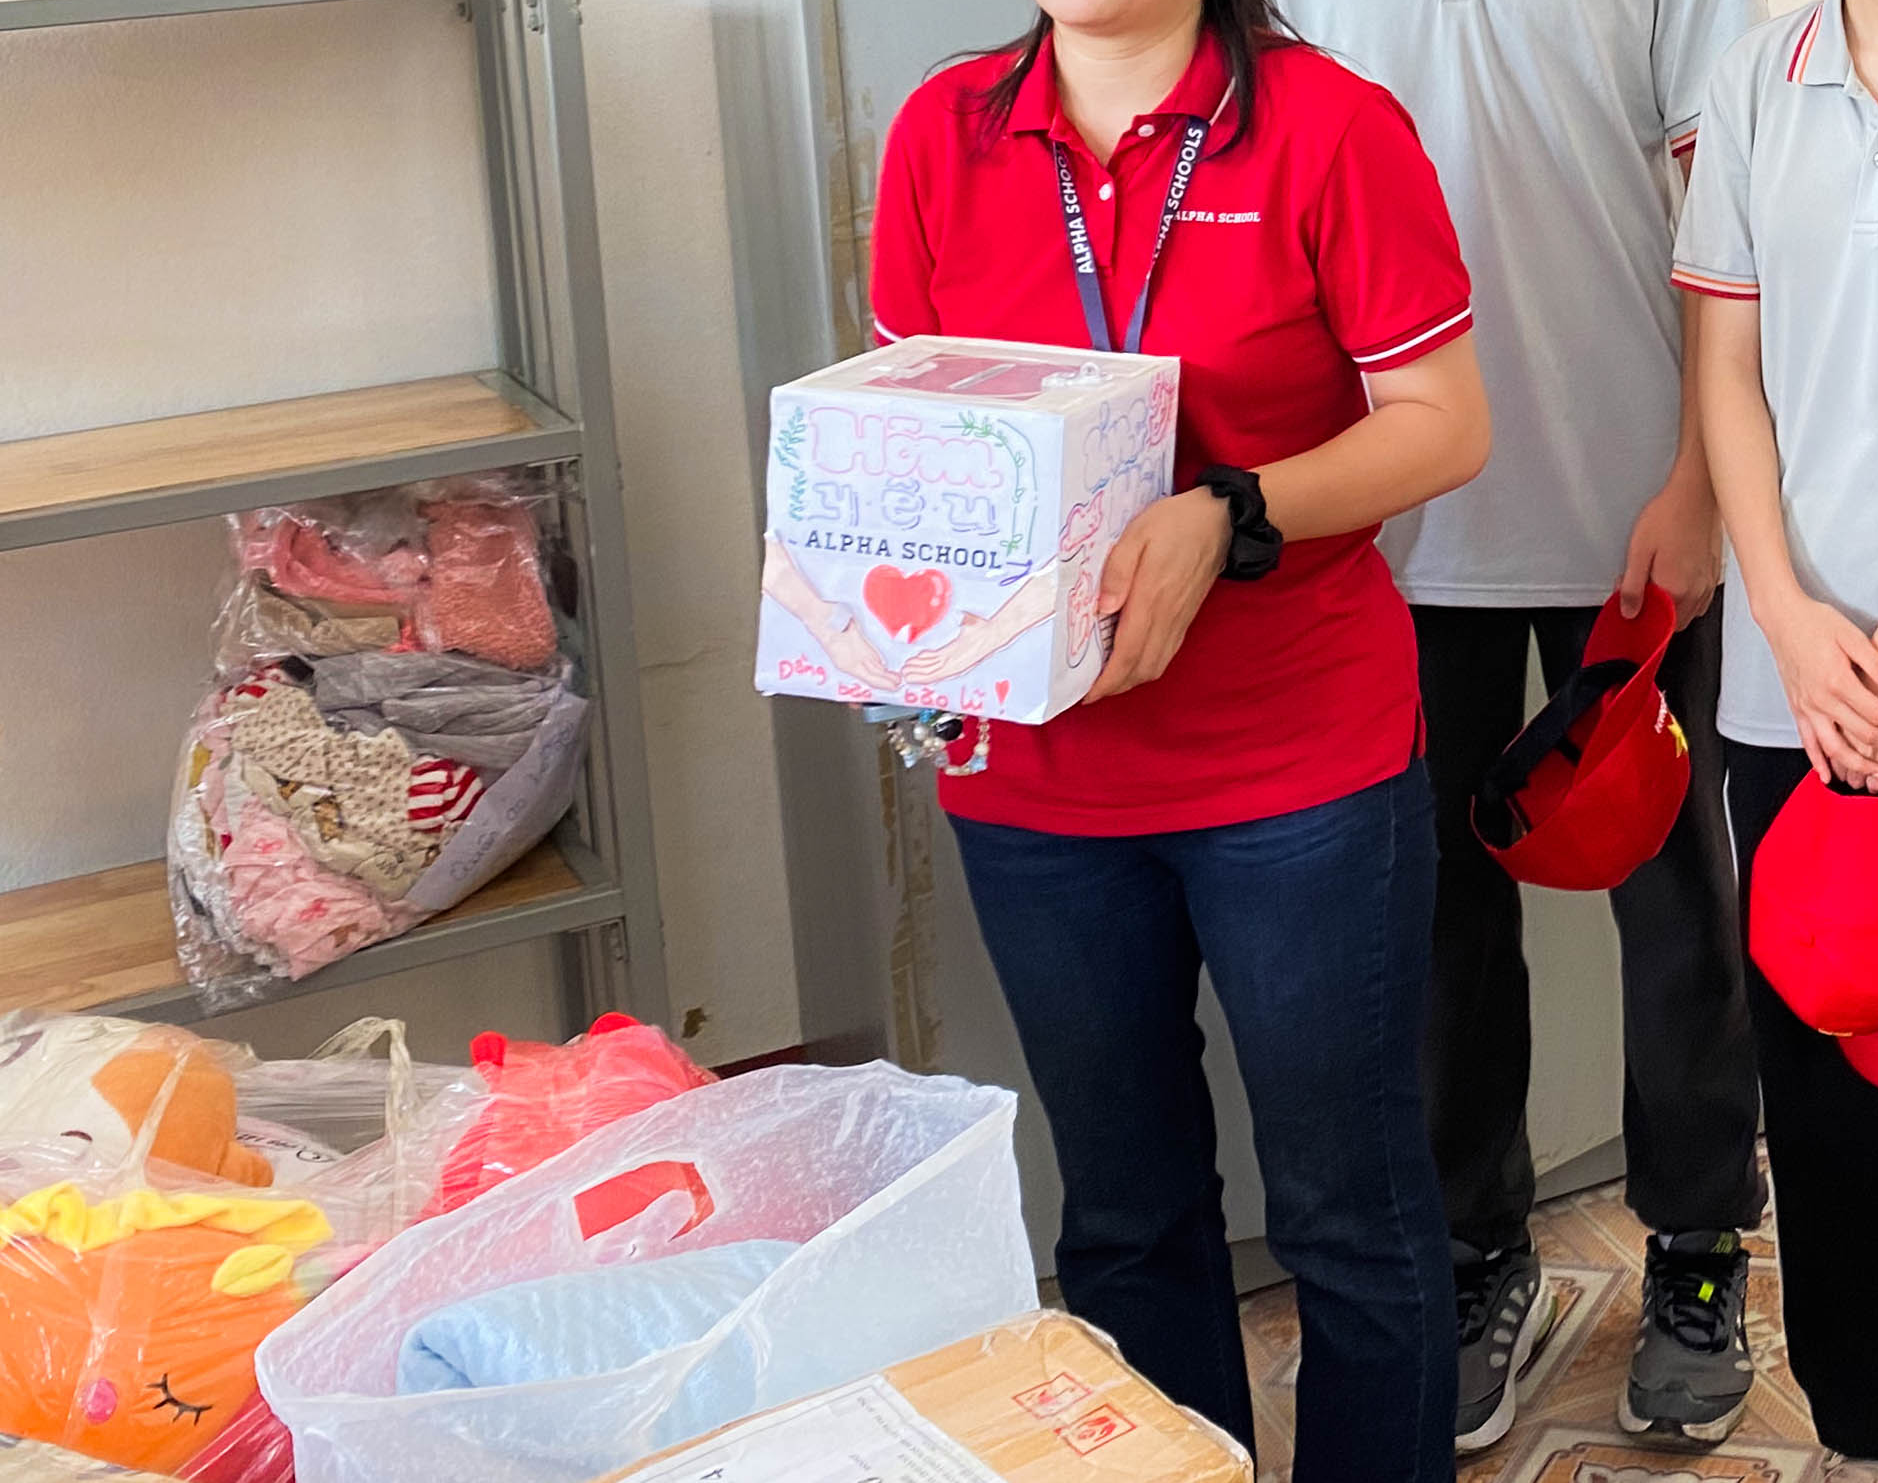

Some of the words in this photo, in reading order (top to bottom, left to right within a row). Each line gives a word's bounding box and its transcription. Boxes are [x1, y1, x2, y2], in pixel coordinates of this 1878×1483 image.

[1167, 126, 1204, 211] SCHOOLS
[1217, 211, 1261, 223] SCHOOL
[1068, 216, 1096, 275] ALPHA
[805, 530, 892, 559] ALPHA
[901, 542, 1003, 570] SCHOOL
